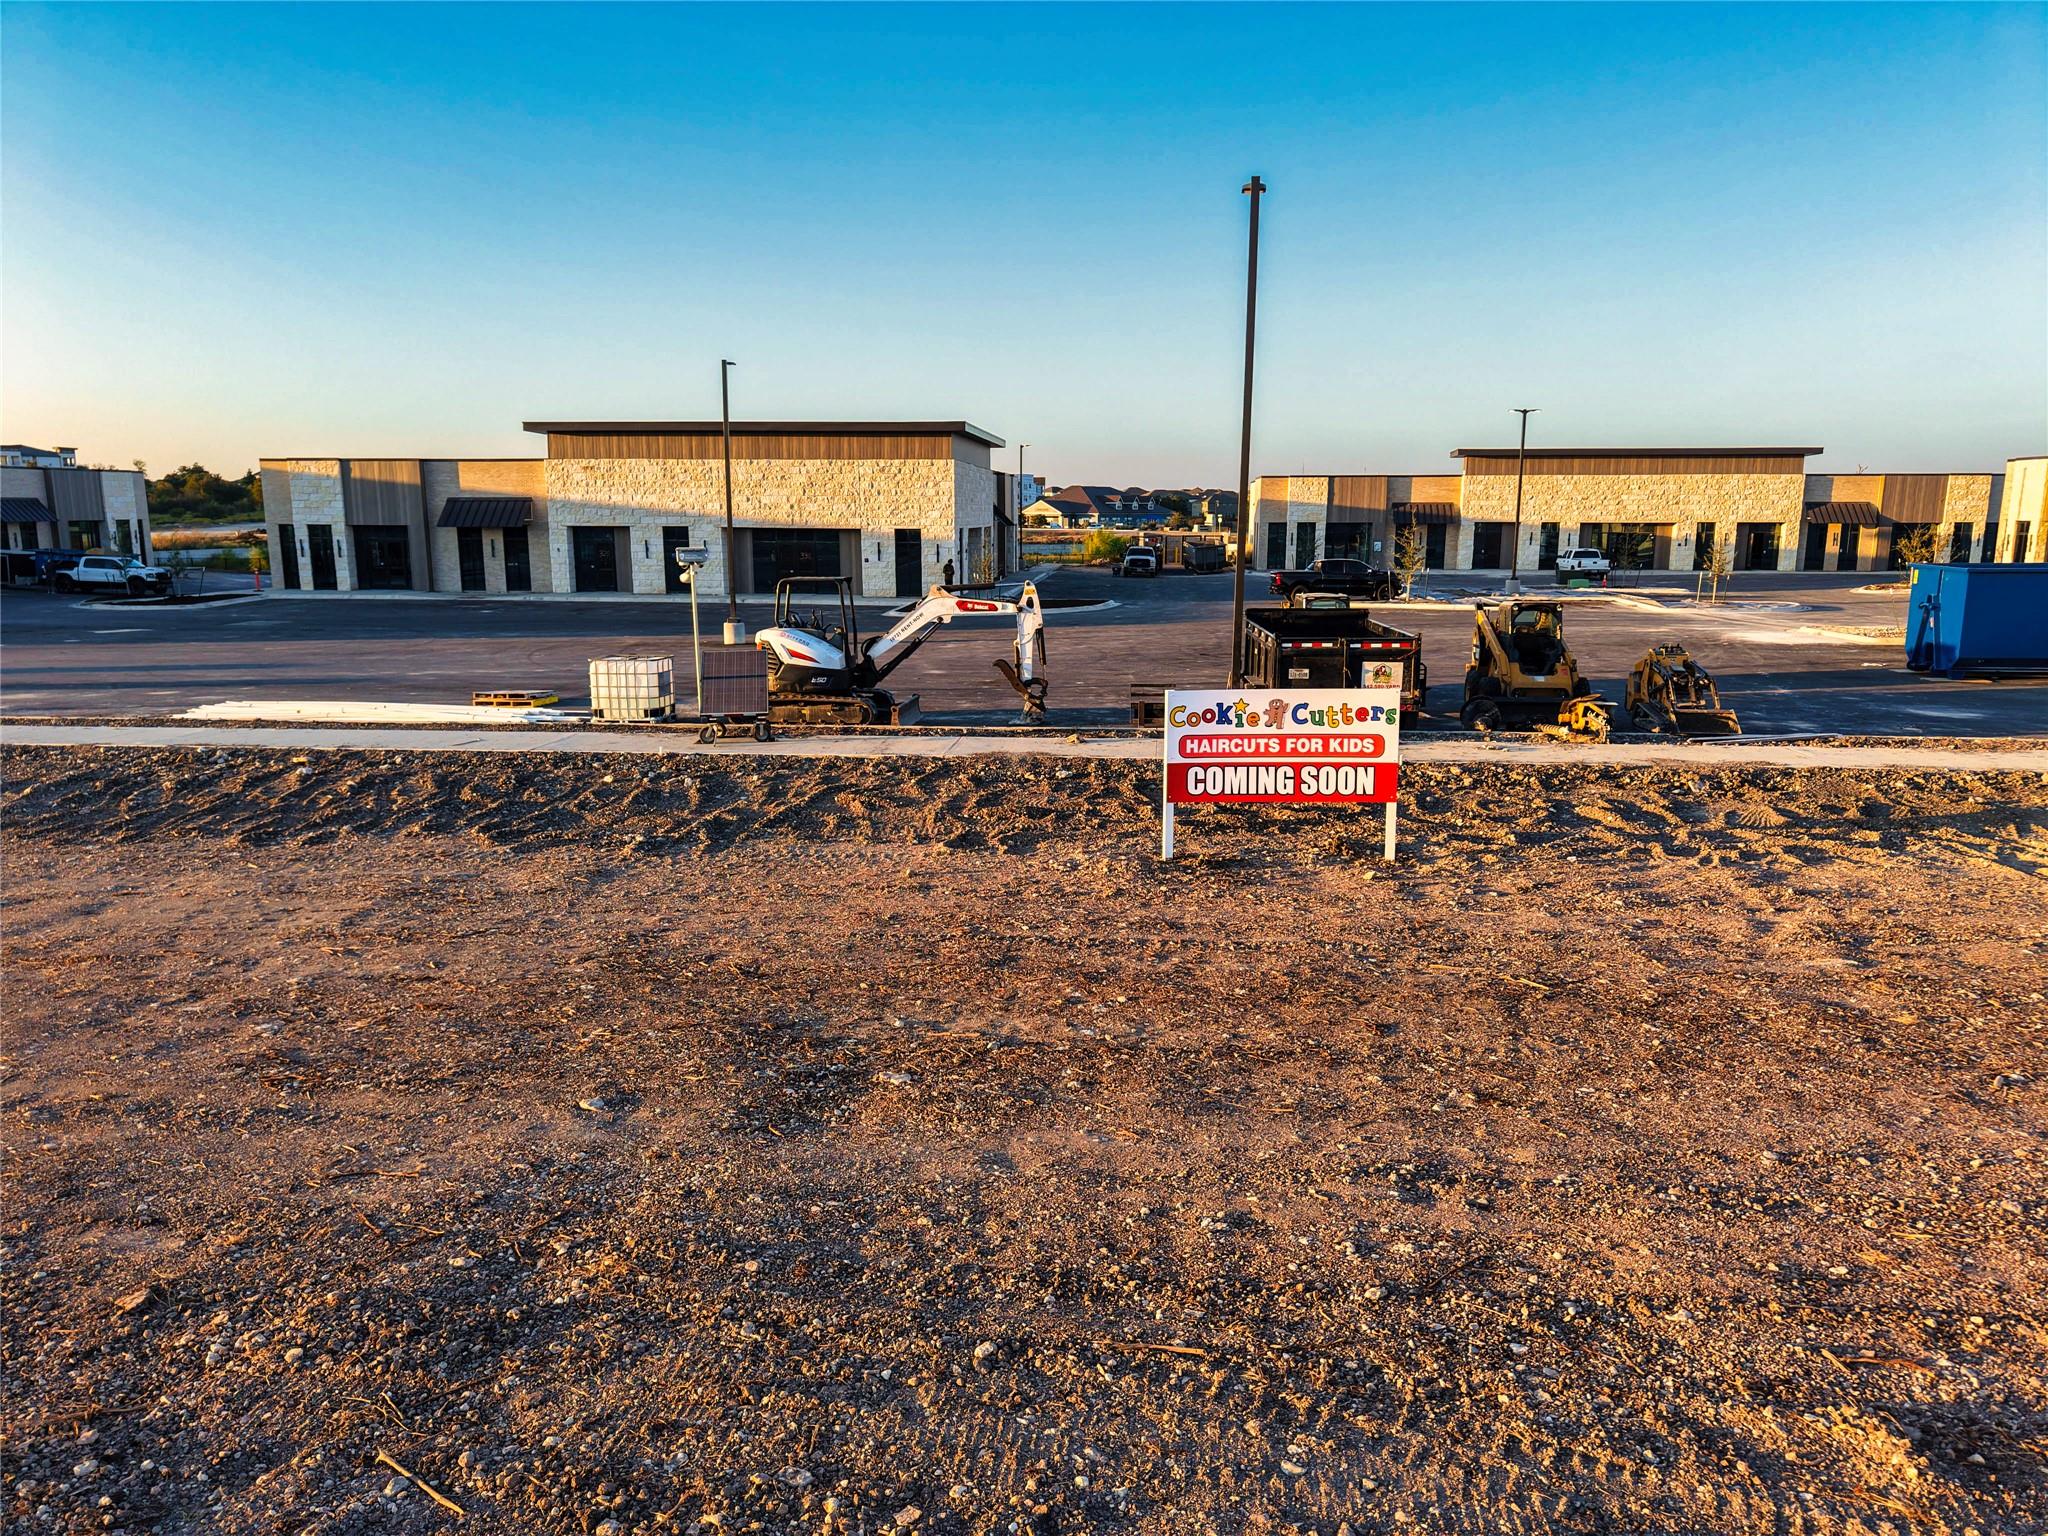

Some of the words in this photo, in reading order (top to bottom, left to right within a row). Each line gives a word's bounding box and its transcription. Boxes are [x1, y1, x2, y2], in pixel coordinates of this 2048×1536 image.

[1169, 698, 1260, 728] Cookie
[1291, 702, 1397, 729] Cutters
[1186, 738, 1280, 754] HAIRCUTS
[1285, 738, 1325, 753] FOR
[1330, 737, 1375, 753] KIDS
[1186, 766, 1295, 795] COMING
[1300, 765, 1375, 795] SOON
